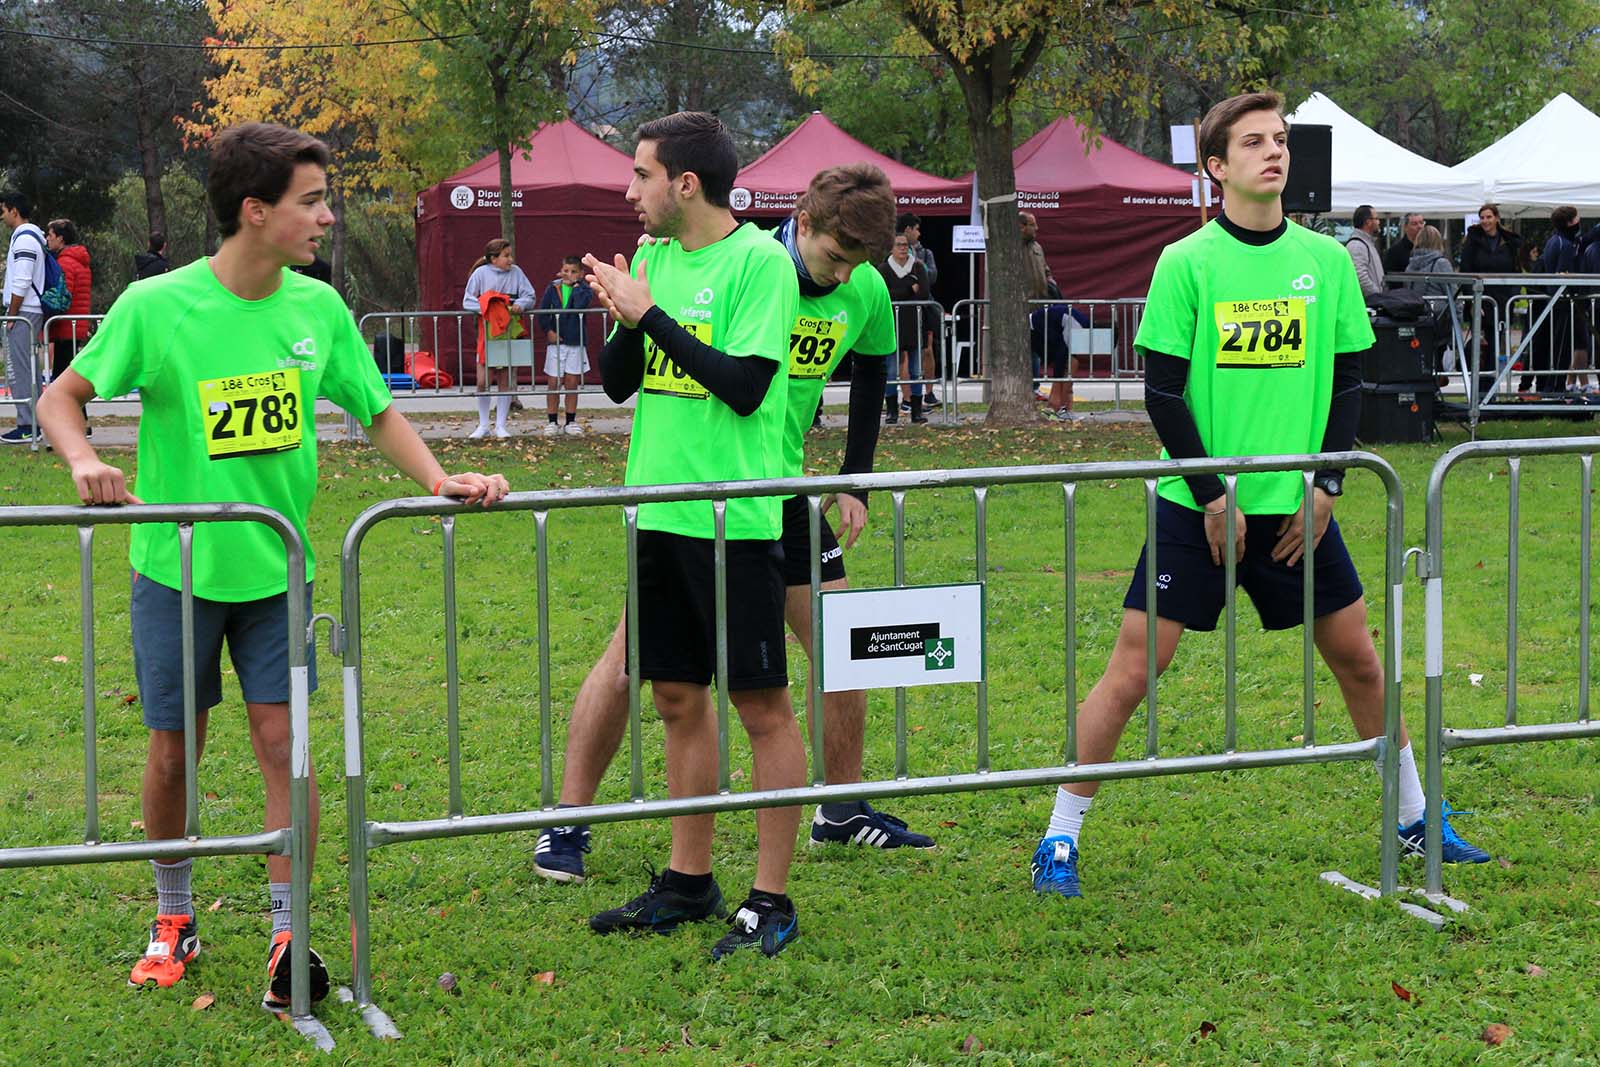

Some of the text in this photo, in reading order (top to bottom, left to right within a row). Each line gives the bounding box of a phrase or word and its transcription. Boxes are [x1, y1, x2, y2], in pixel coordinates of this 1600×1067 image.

[477, 190, 523, 199] Dipuió
[754, 191, 798, 201] Diputació
[1017, 191, 1060, 200] Diputació
[477, 199, 523, 208] Barcena
[898, 196, 909, 204] de
[911, 196, 942, 206] l'esport
[943, 195, 963, 204] local
[1017, 200, 1060, 209] Barcelona
[1122, 196, 1193, 206] al servei de l'espo
[1232, 302, 1273, 313] 18è Cros
[799, 318, 817, 328] Cros
[1221, 319, 1302, 353] 2784
[790, 334, 836, 366] 793
[247, 377, 270, 387] Cros
[209, 392, 298, 440] 2783
[870, 631, 920, 643] Ajuntament
[867, 643, 879, 653] de
